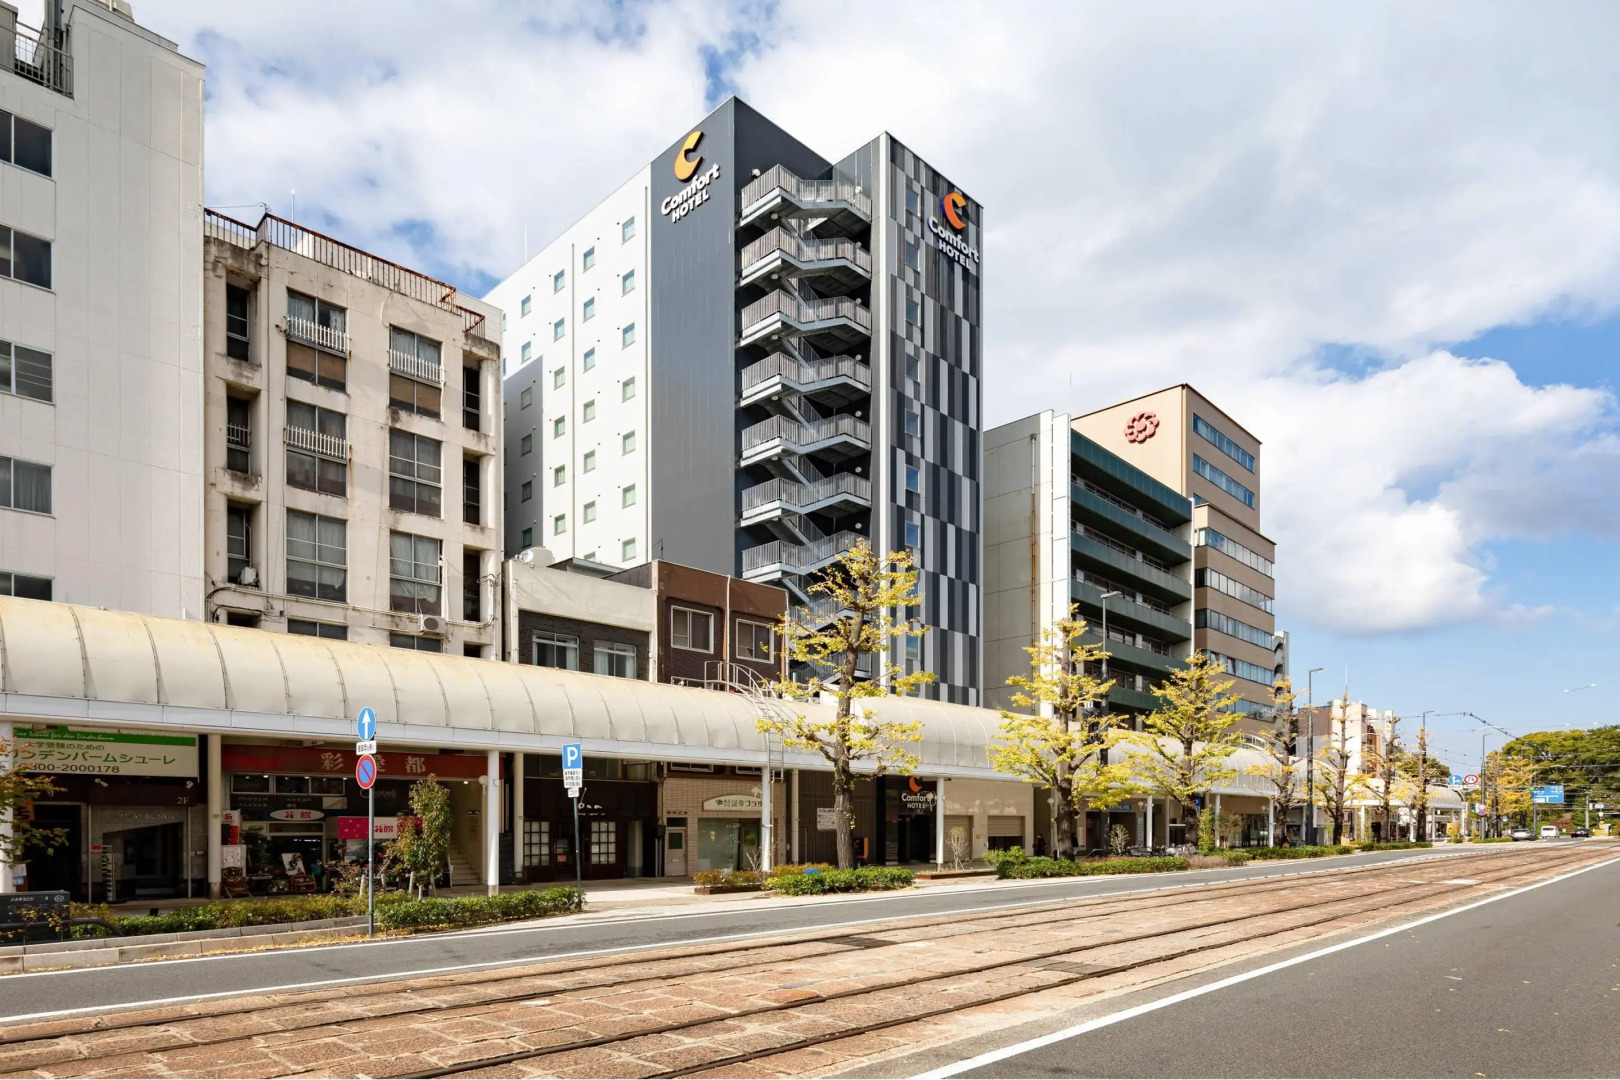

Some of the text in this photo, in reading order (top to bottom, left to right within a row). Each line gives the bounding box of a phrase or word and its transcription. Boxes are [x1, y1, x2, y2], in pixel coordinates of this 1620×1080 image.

[661, 163, 720, 215] Comfort
[672, 188, 710, 223] HOTEL
[927, 215, 979, 263] Comfort
[939, 239, 972, 270] HOTEL
[567, 746, 578, 767] P
